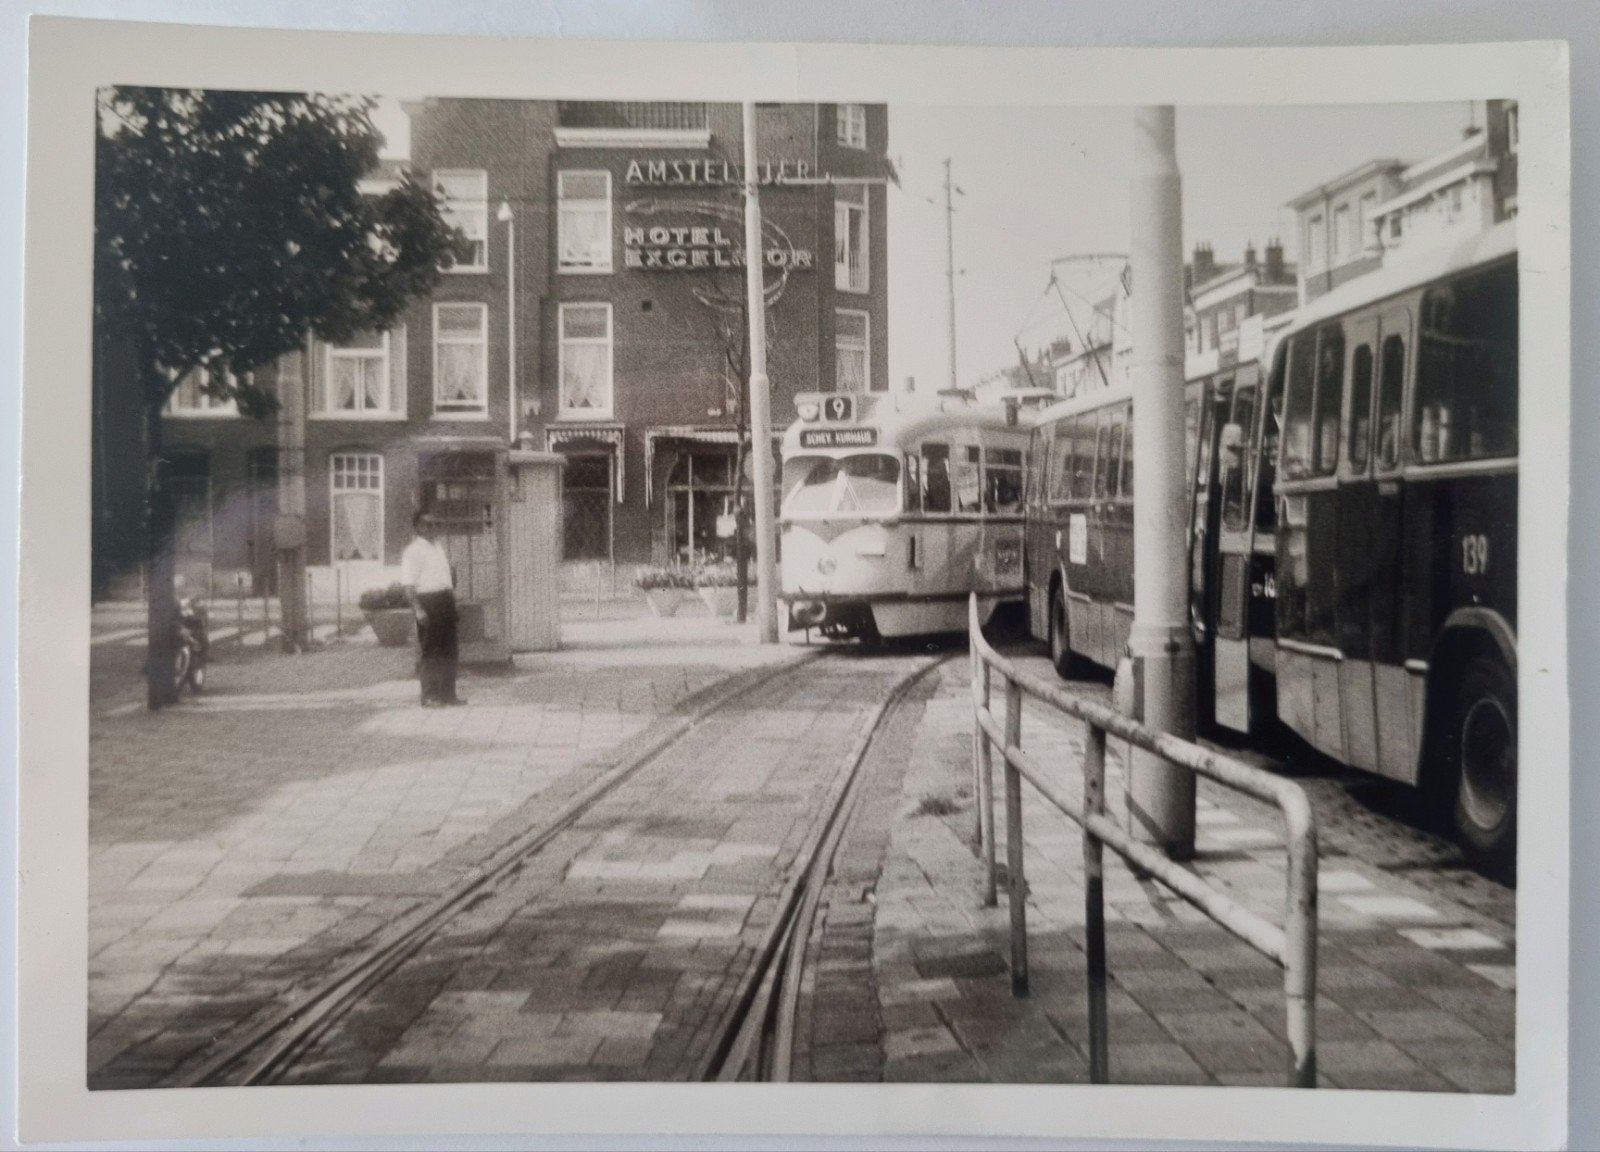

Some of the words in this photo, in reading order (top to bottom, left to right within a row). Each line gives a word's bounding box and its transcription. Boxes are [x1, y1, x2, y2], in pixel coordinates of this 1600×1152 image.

[624, 226, 731, 246] HOTEL
[832, 398, 845, 420] 9
[1462, 534, 1488, 575] 139
